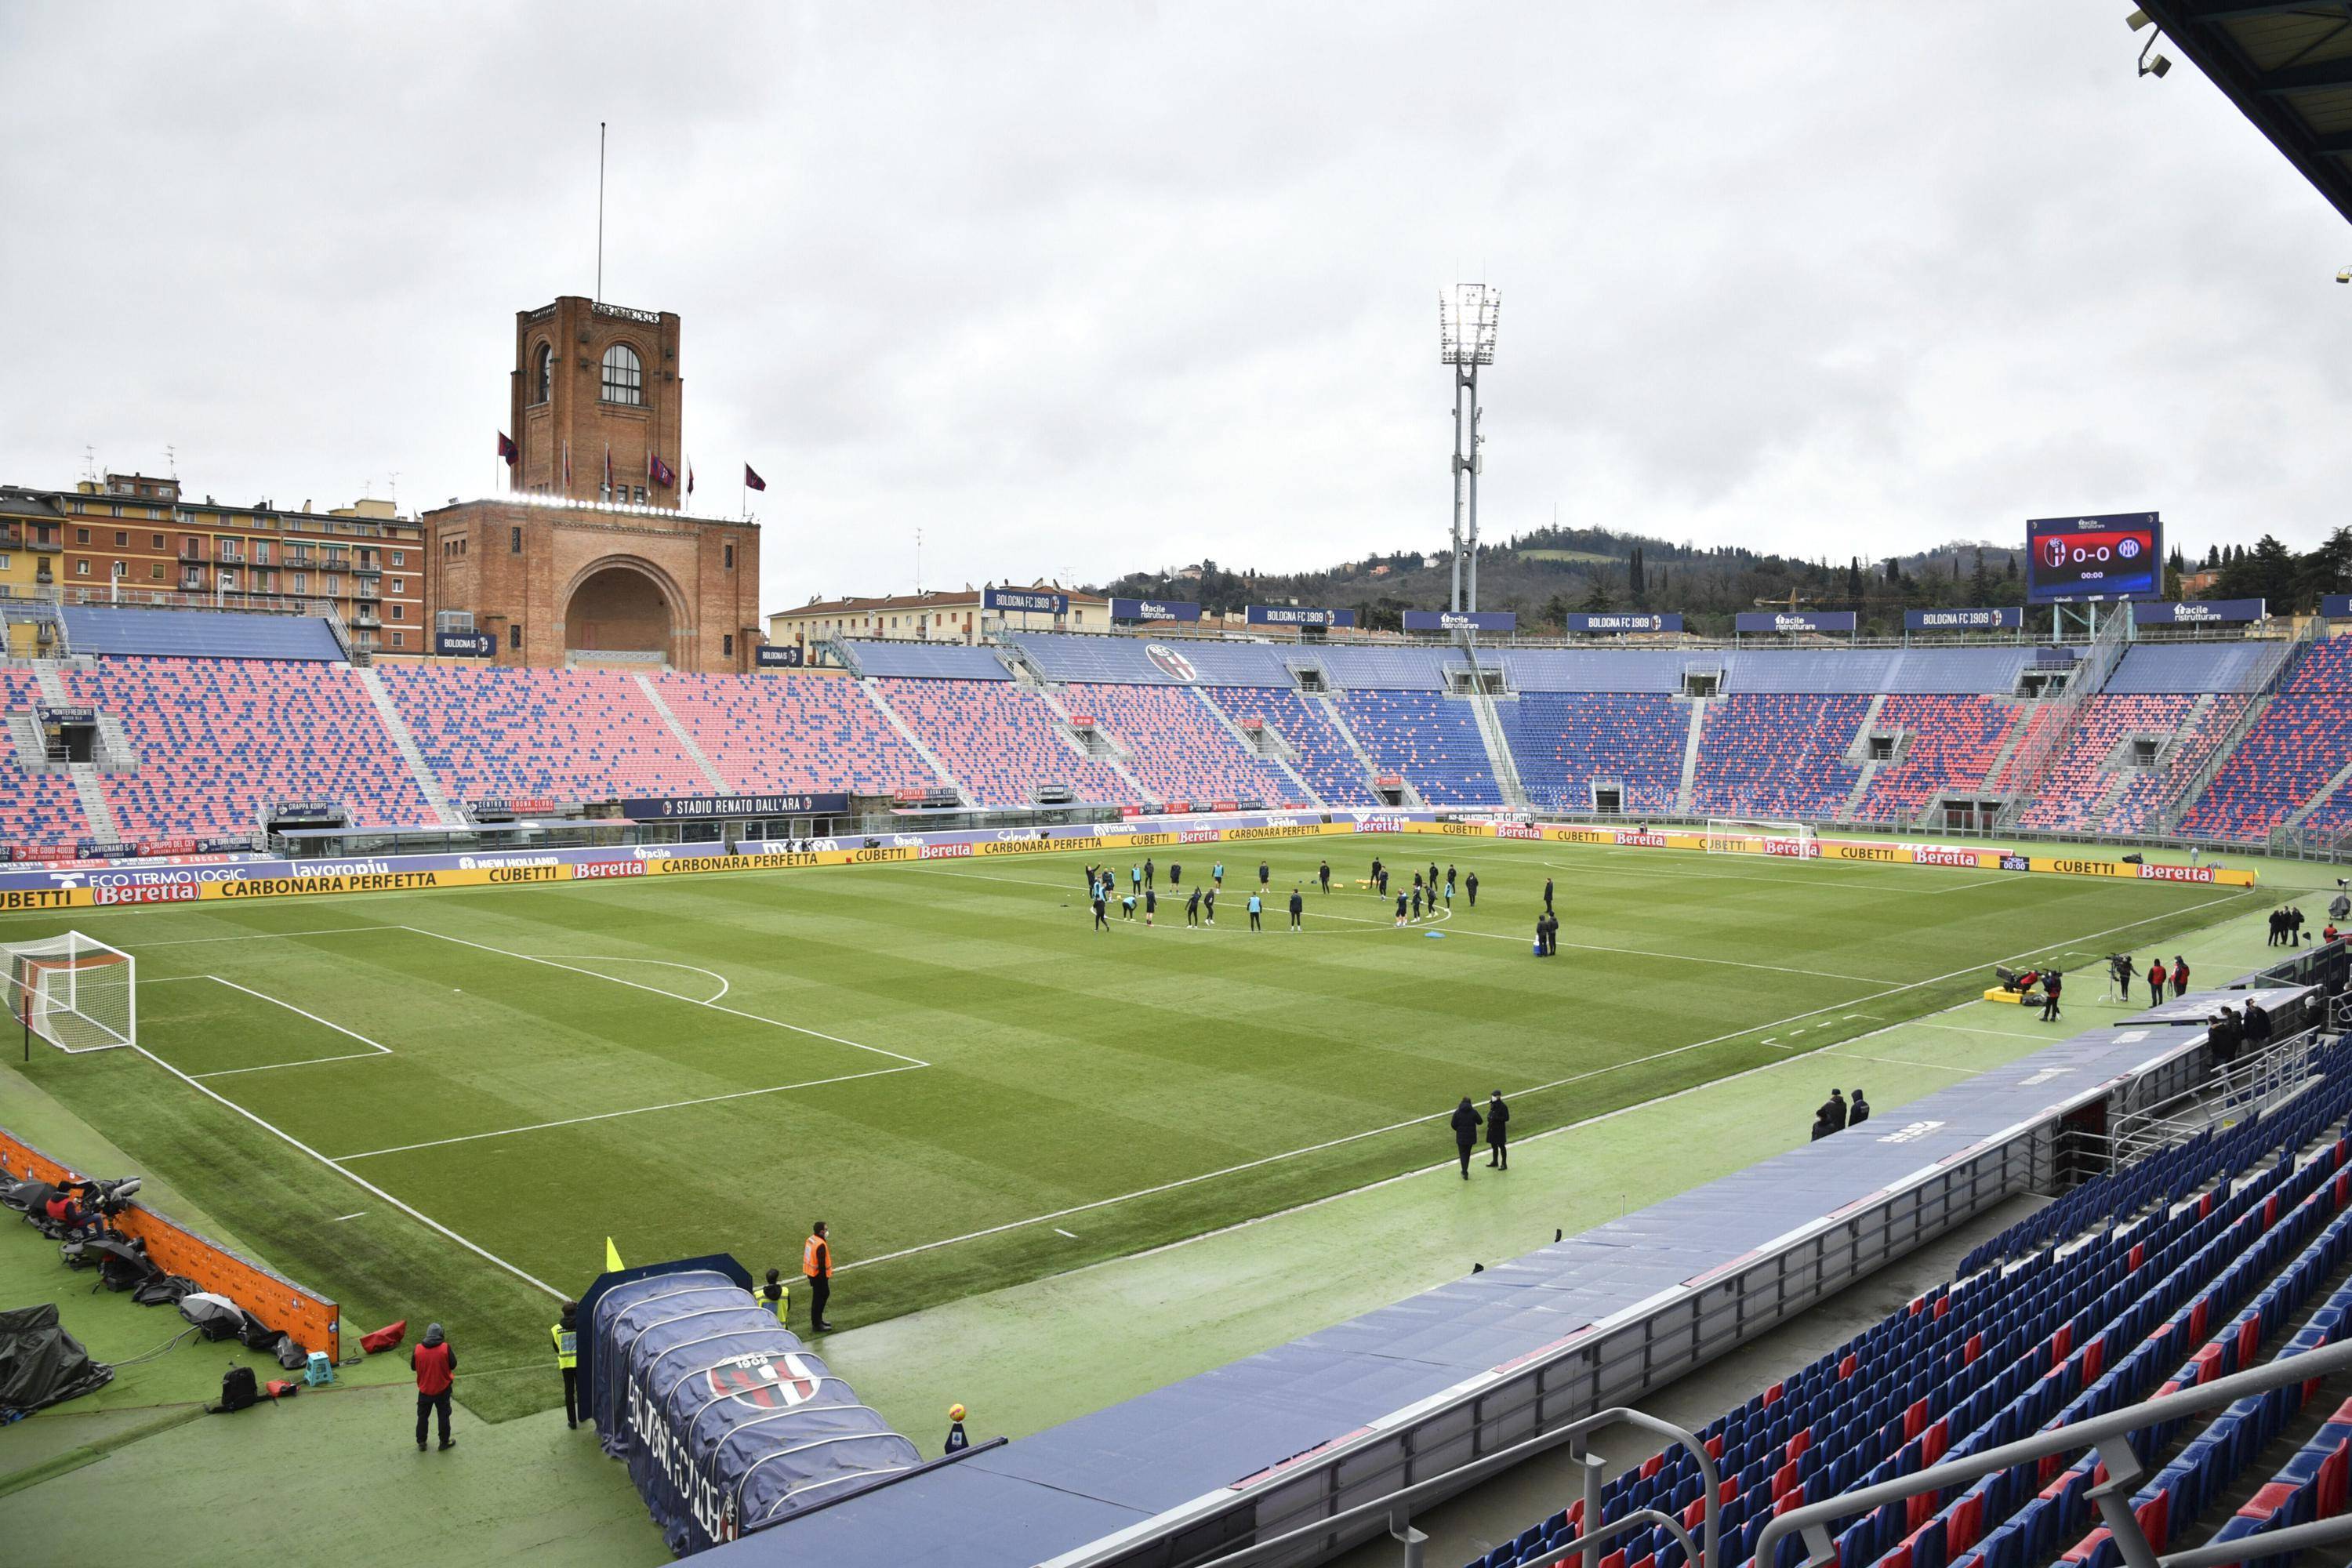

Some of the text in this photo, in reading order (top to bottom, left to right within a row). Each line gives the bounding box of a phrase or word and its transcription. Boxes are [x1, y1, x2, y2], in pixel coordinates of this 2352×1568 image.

[996, 594, 1049, 608] BOLOGNA FC 1909
[1267, 610, 1323, 622] BOLOGNA FC 1909
[1588, 617, 1650, 627] BOLOGNA FC 1909
[1923, 612, 1988, 625] BOLOGNA FC 1909
[2175, 612, 2221, 622] ristrutturare
[444, 638, 470, 648] BOLOGNA
[762, 652, 782, 660] BOLOGNA
[677, 797, 800, 814] STADIO RENATO DALL'ARA
[1104, 824, 1137, 833] Vittoria
[90, 844, 123, 853] SAVIGNANO
[151, 840, 172, 850] GRUPPO
[185, 839, 194, 848] CEV
[1443, 824, 1482, 835] CUBETTI
[1497, 826, 1540, 839] Beretta
[1557, 831, 1599, 842] CUBETTI
[1615, 833, 1664, 847] Beretta
[1699, 839, 1746, 851] CUBETTI
[1841, 847, 1893, 860] CUBETTI
[1916, 850, 1974, 866] Beretta
[99, 884, 194, 905] Beretta
[222, 877, 343, 897] CARBONARA
[350, 872, 436, 889] PERFETTA
[489, 866, 557, 881] CUBETTI
[577, 861, 643, 879] Beretta
[662, 856, 750, 873] CARBONARA
[754, 853, 818, 867] PERFETTA
[856, 848, 906, 861] CUBETTI
[920, 844, 971, 859] Beretta
[985, 840, 1051, 855] CARBONARA
[1054, 837, 1102, 851] PERFETTA
[1131, 833, 1170, 845] CUBETTI
[1180, 831, 1218, 844] Beretta
[1229, 827, 1279, 839] CARBONARA
[1283, 826, 1320, 836] PERFETTA
[1355, 822, 1400, 833] Beretta
[477, 857, 558, 869] NEW HOLLAND
[2004, 862, 2026, 870] 00:00
[2053, 859, 2209, 882] CUBETTI Beretta
[89, 869, 247, 887] ECO TERMO LOGIC
[736, 1356, 768, 1369] 1909
